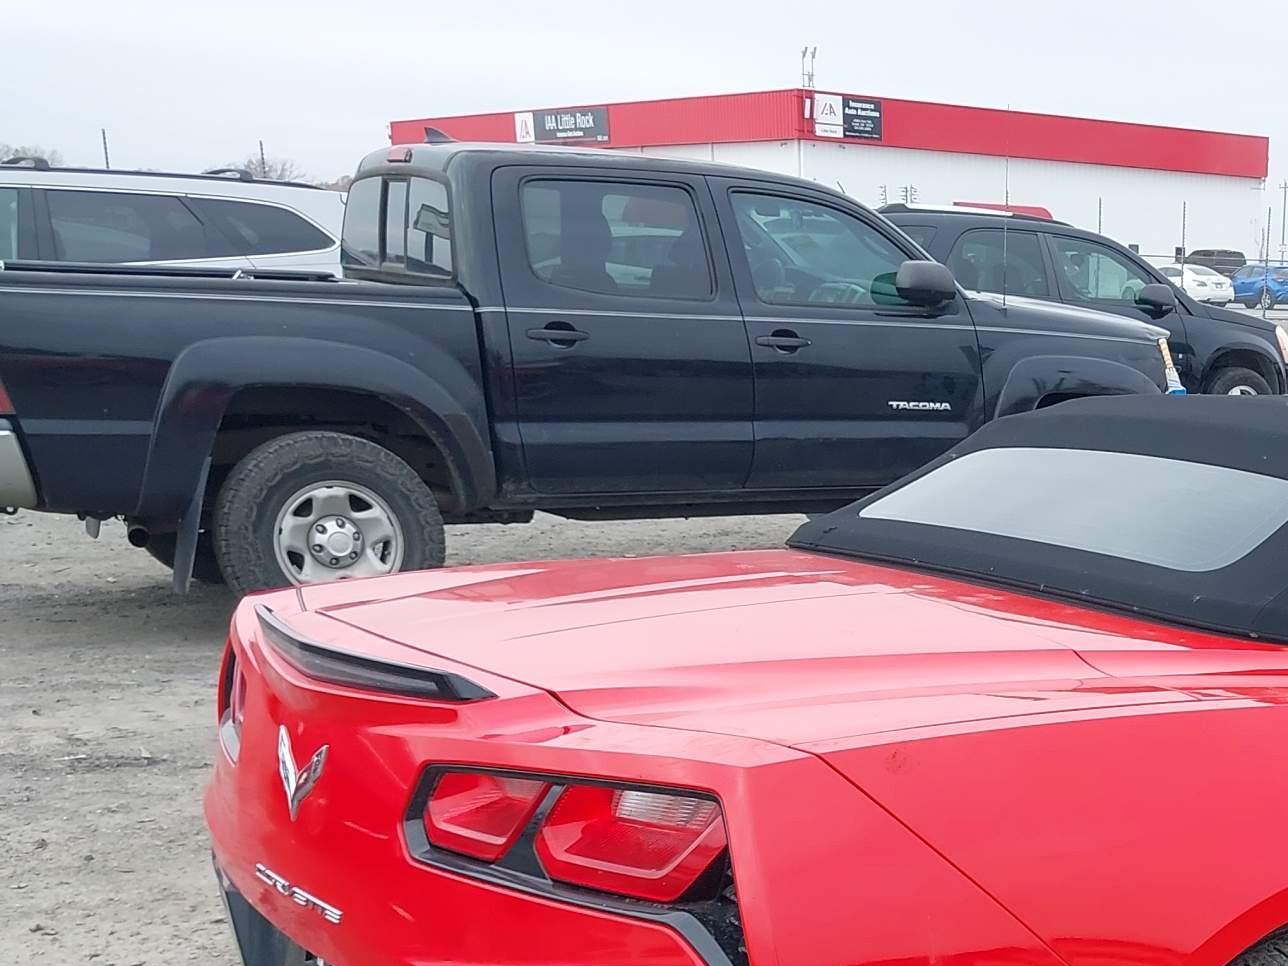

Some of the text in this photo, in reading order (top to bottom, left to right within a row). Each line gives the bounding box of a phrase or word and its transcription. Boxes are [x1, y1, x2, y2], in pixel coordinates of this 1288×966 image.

[544, 115, 557, 130] IAA
[557, 113, 576, 130] Little
[576, 111, 595, 129] Rock
[888, 401, 952, 411] TACOMA
